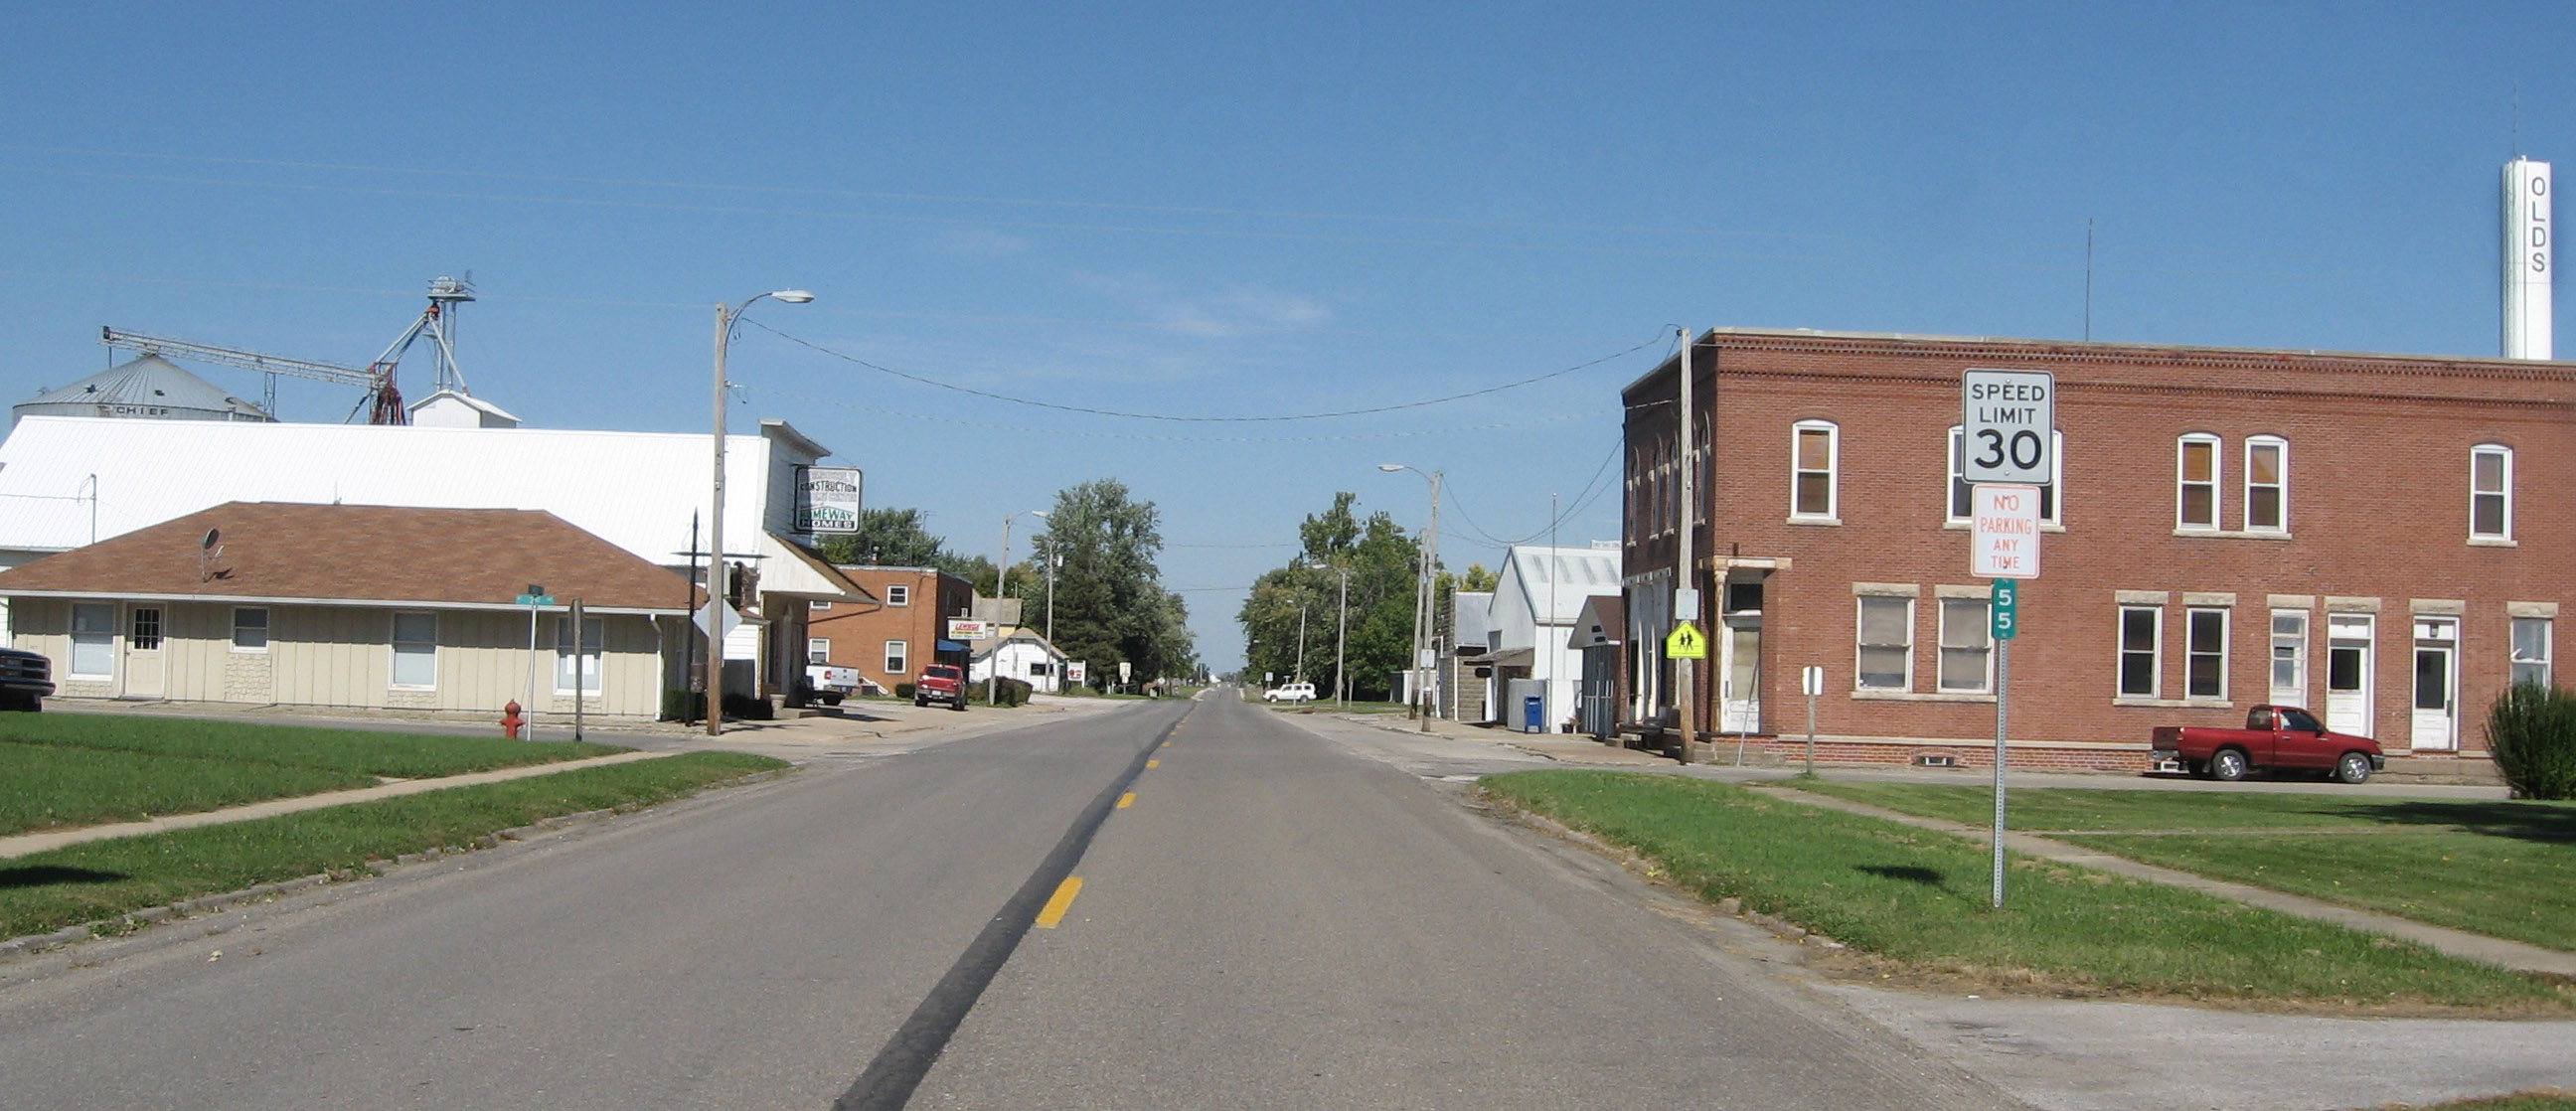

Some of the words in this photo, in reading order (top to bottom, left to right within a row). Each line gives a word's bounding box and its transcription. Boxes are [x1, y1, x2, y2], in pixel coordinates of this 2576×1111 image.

[2531, 176, 2546, 272] OLDS
[1972, 384, 2045, 401] SPEED
[116, 406, 168, 415] CHIEF
[1980, 406, 2036, 424] LIMIT
[1974, 428, 2042, 470] 30
[800, 480, 858, 493] CONSTRUCTION
[1994, 494, 2019, 511] NO
[1980, 517, 2032, 535] PARKING
[1993, 539, 2019, 552] ANY
[1991, 556, 2020, 569] TIME
